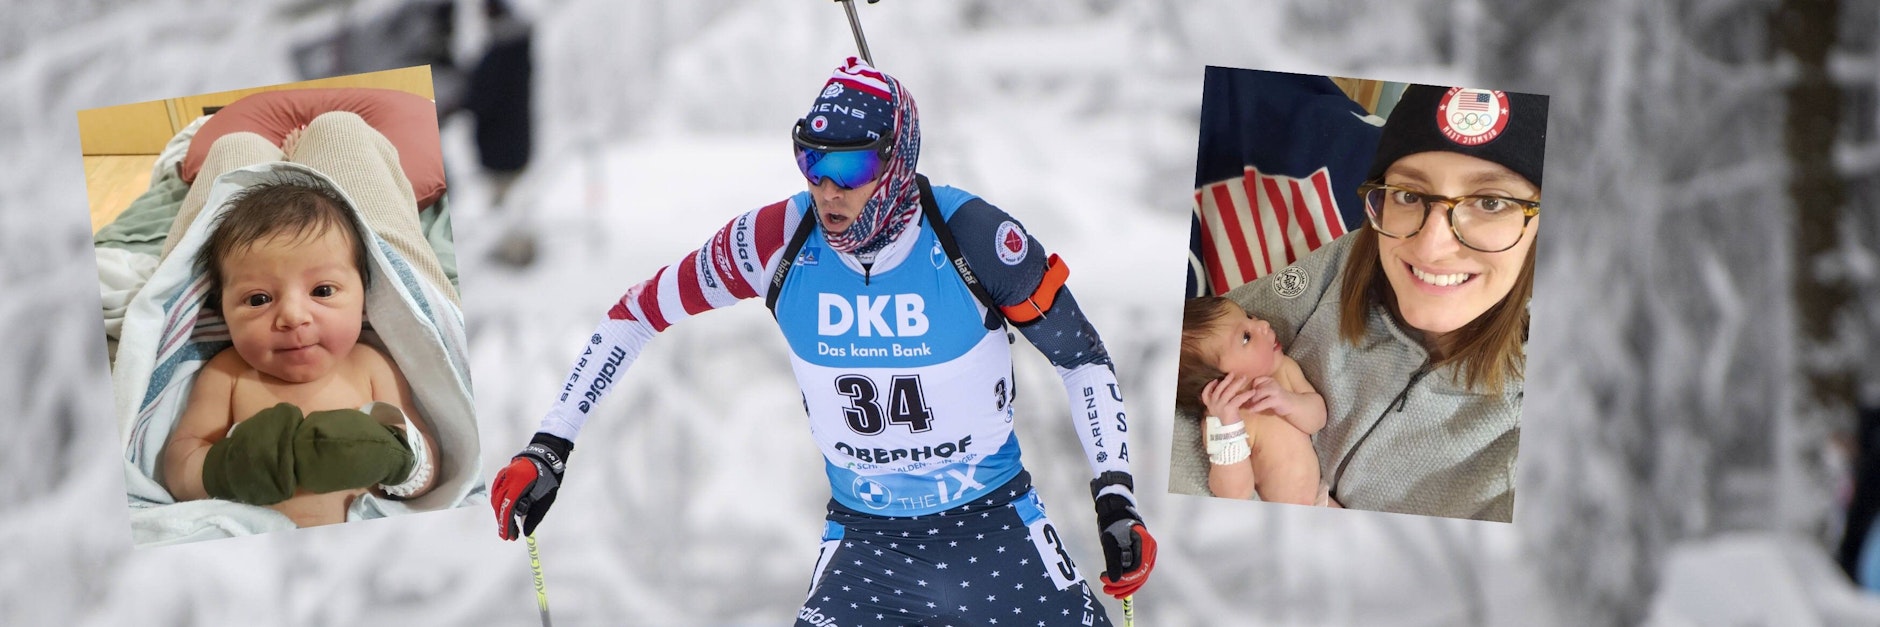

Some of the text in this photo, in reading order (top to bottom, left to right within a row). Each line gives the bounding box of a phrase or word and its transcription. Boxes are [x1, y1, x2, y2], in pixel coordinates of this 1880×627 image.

[818, 292, 930, 338] DKB
[818, 341, 932, 357] Das kann Bank
[585, 345, 627, 404] maloja
[834, 374, 935, 436] 34
[1083, 386, 1104, 448] ARIENS
[834, 434, 972, 464] OBERHOF
[897, 494, 937, 509] THE
